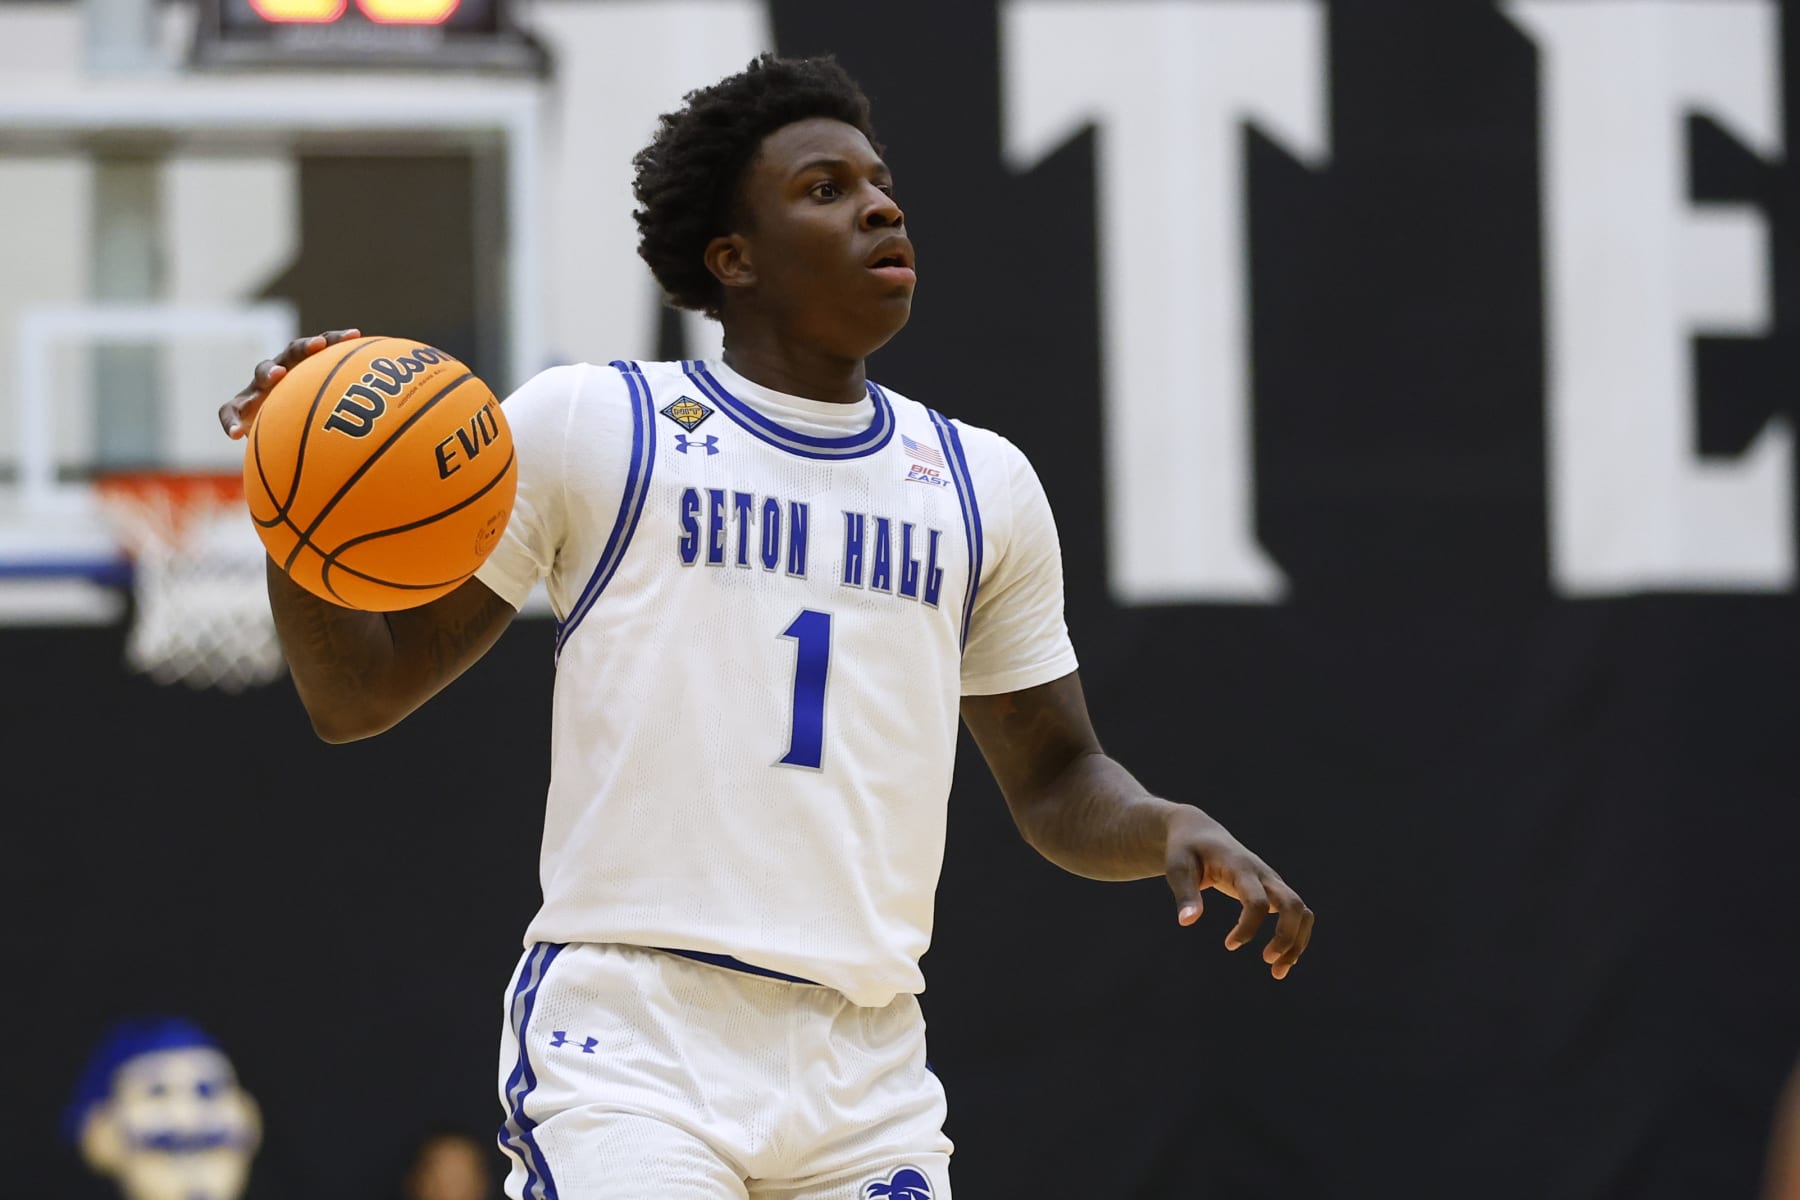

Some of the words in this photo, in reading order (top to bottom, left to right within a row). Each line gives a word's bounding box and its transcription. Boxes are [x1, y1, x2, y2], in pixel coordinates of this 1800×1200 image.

[434, 403, 500, 480] EVO
[908, 471, 951, 487] EAST
[911, 464, 940, 477] BIG
[677, 486, 810, 580] SETON
[840, 510, 945, 608] HALL
[770, 606, 834, 773] 1
